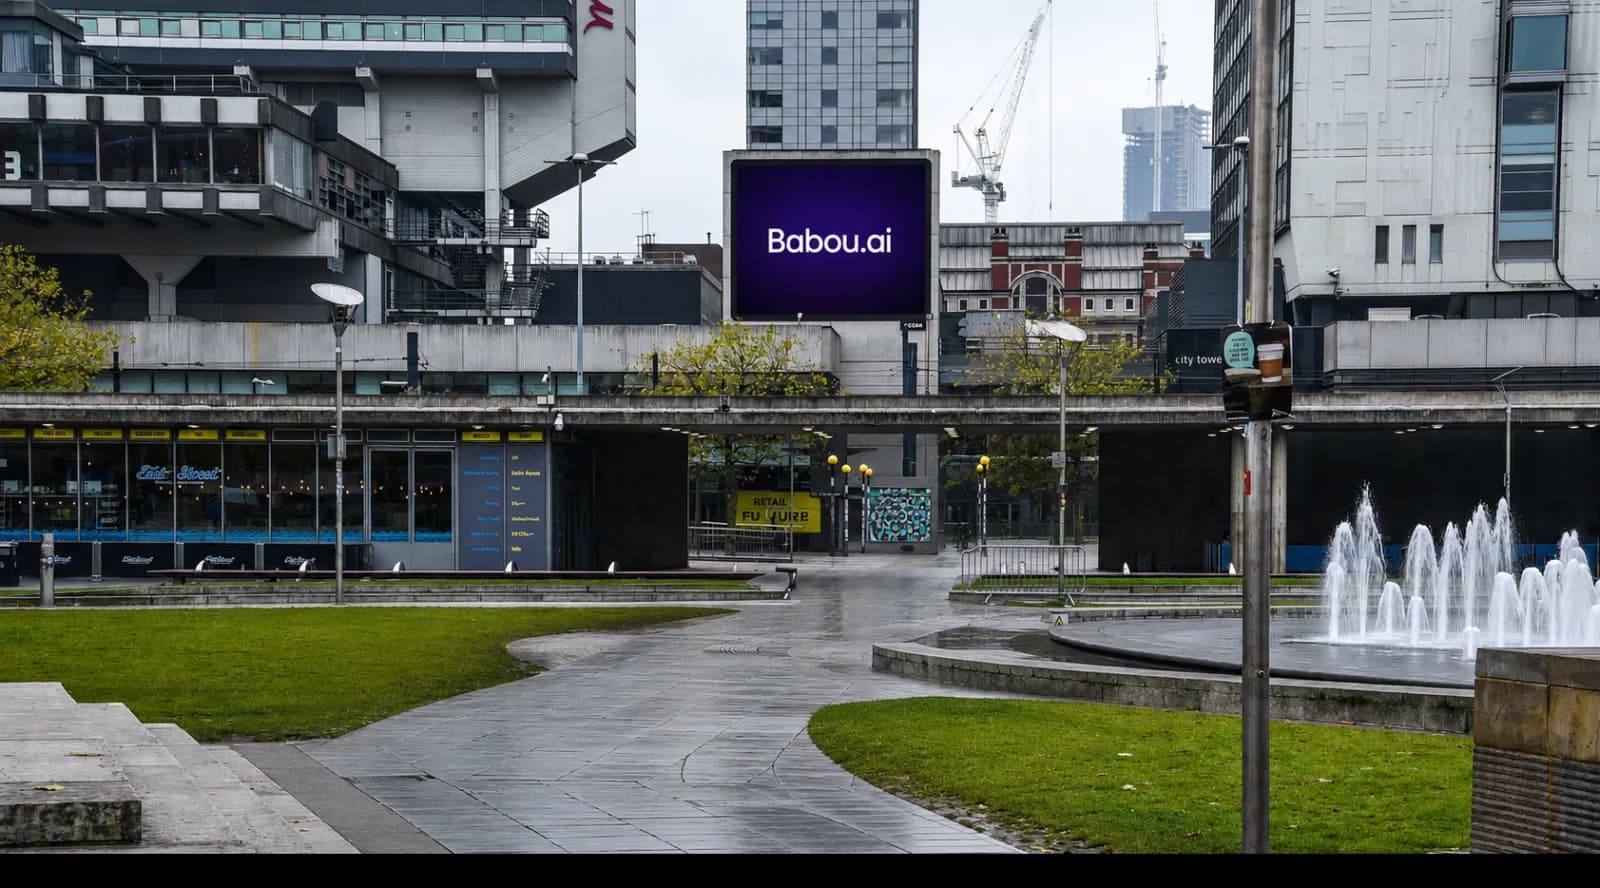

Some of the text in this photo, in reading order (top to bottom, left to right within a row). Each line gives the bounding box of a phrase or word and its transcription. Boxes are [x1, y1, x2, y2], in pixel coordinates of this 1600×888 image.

[768, 227, 892, 253] Babou.ai
[1175, 354, 1223, 367] city towe
[753, 497, 788, 506] RETAIL
[742, 511, 809, 522] FUURE
